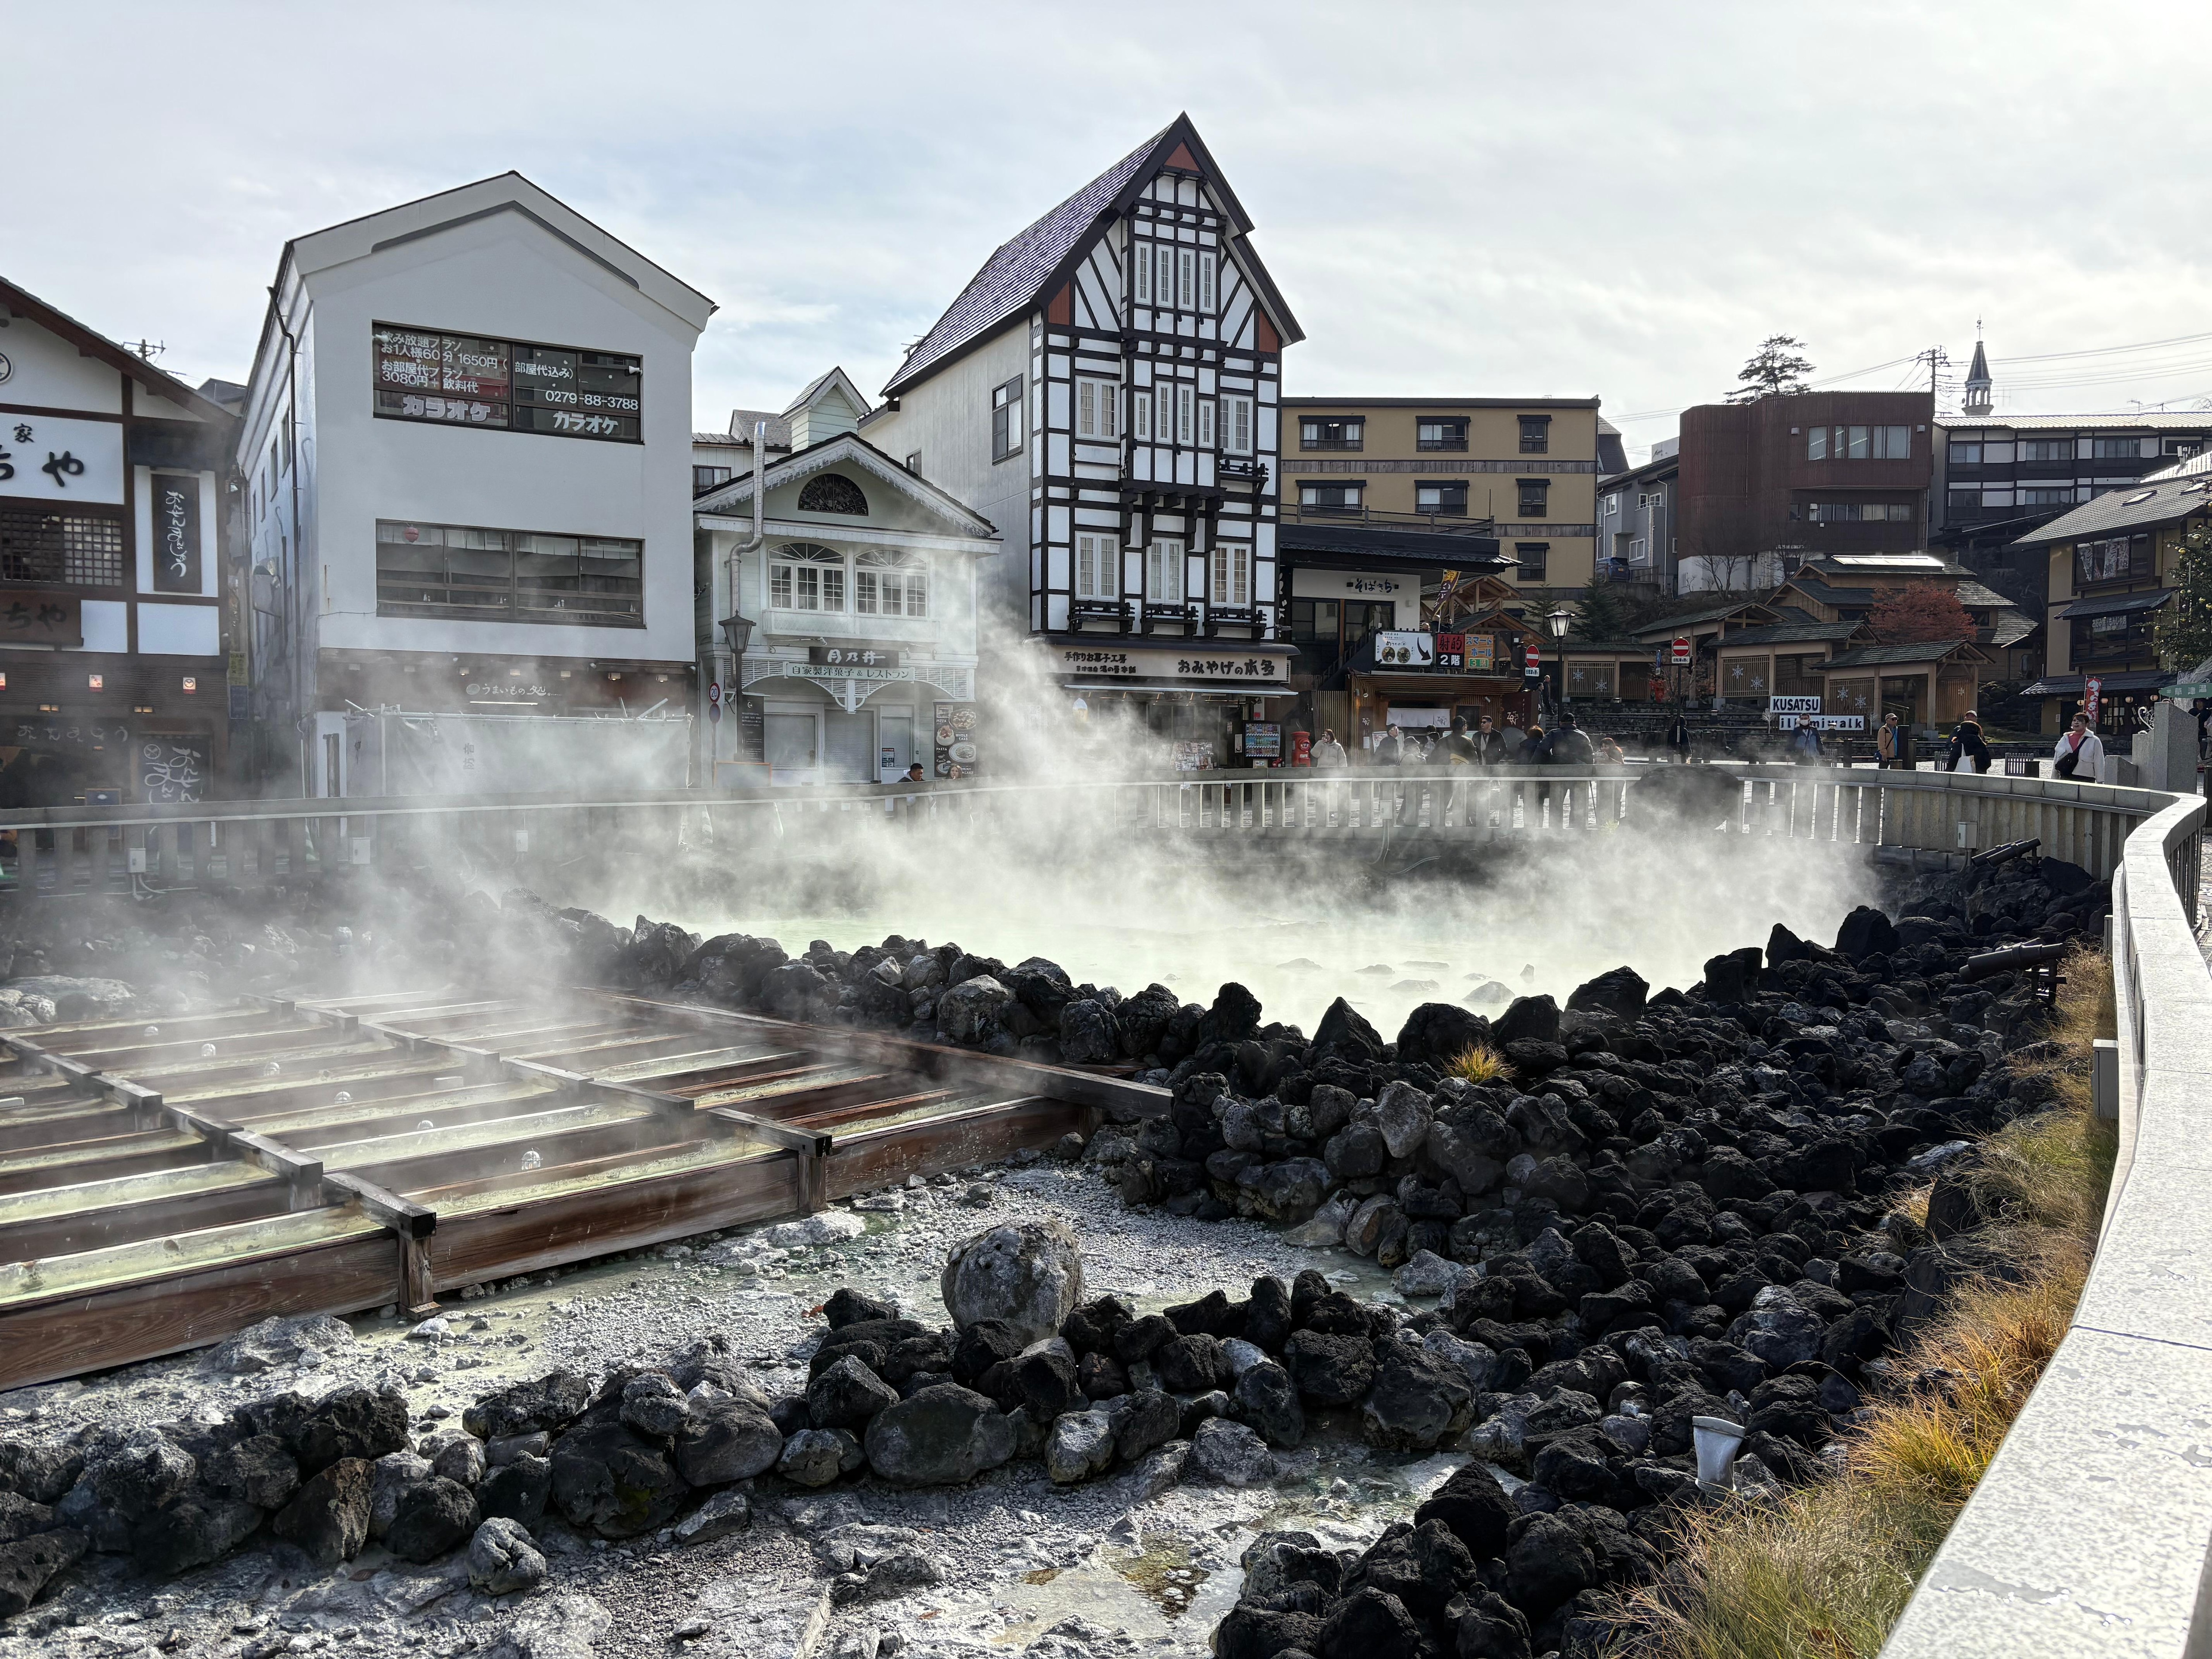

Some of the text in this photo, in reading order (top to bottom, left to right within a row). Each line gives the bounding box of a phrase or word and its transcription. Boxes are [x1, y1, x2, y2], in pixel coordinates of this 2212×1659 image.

[457, 353, 497, 369] 1650円
[403, 395, 491, 422] カラオケ
[545, 390, 638, 411] 0279-88-3788
[553, 411, 618, 435] カラオケ
[13, 423, 35, 443] 家
[1439, 635, 1462, 651] 射的
[1466, 636, 1493, 646] スマート
[827, 649, 886, 665] 月乃井
[1064, 652, 1127, 664] 手作りお菓子工房
[1440, 654, 1460, 665] 2階
[792, 666, 854, 677] 自家製洋菓子
[867, 669, 909, 678] レストラン
[1178, 659, 1275, 676] おみやげの本多
[711, 688, 718, 697] 20
[1773, 699, 1819, 711] KUSATSU
